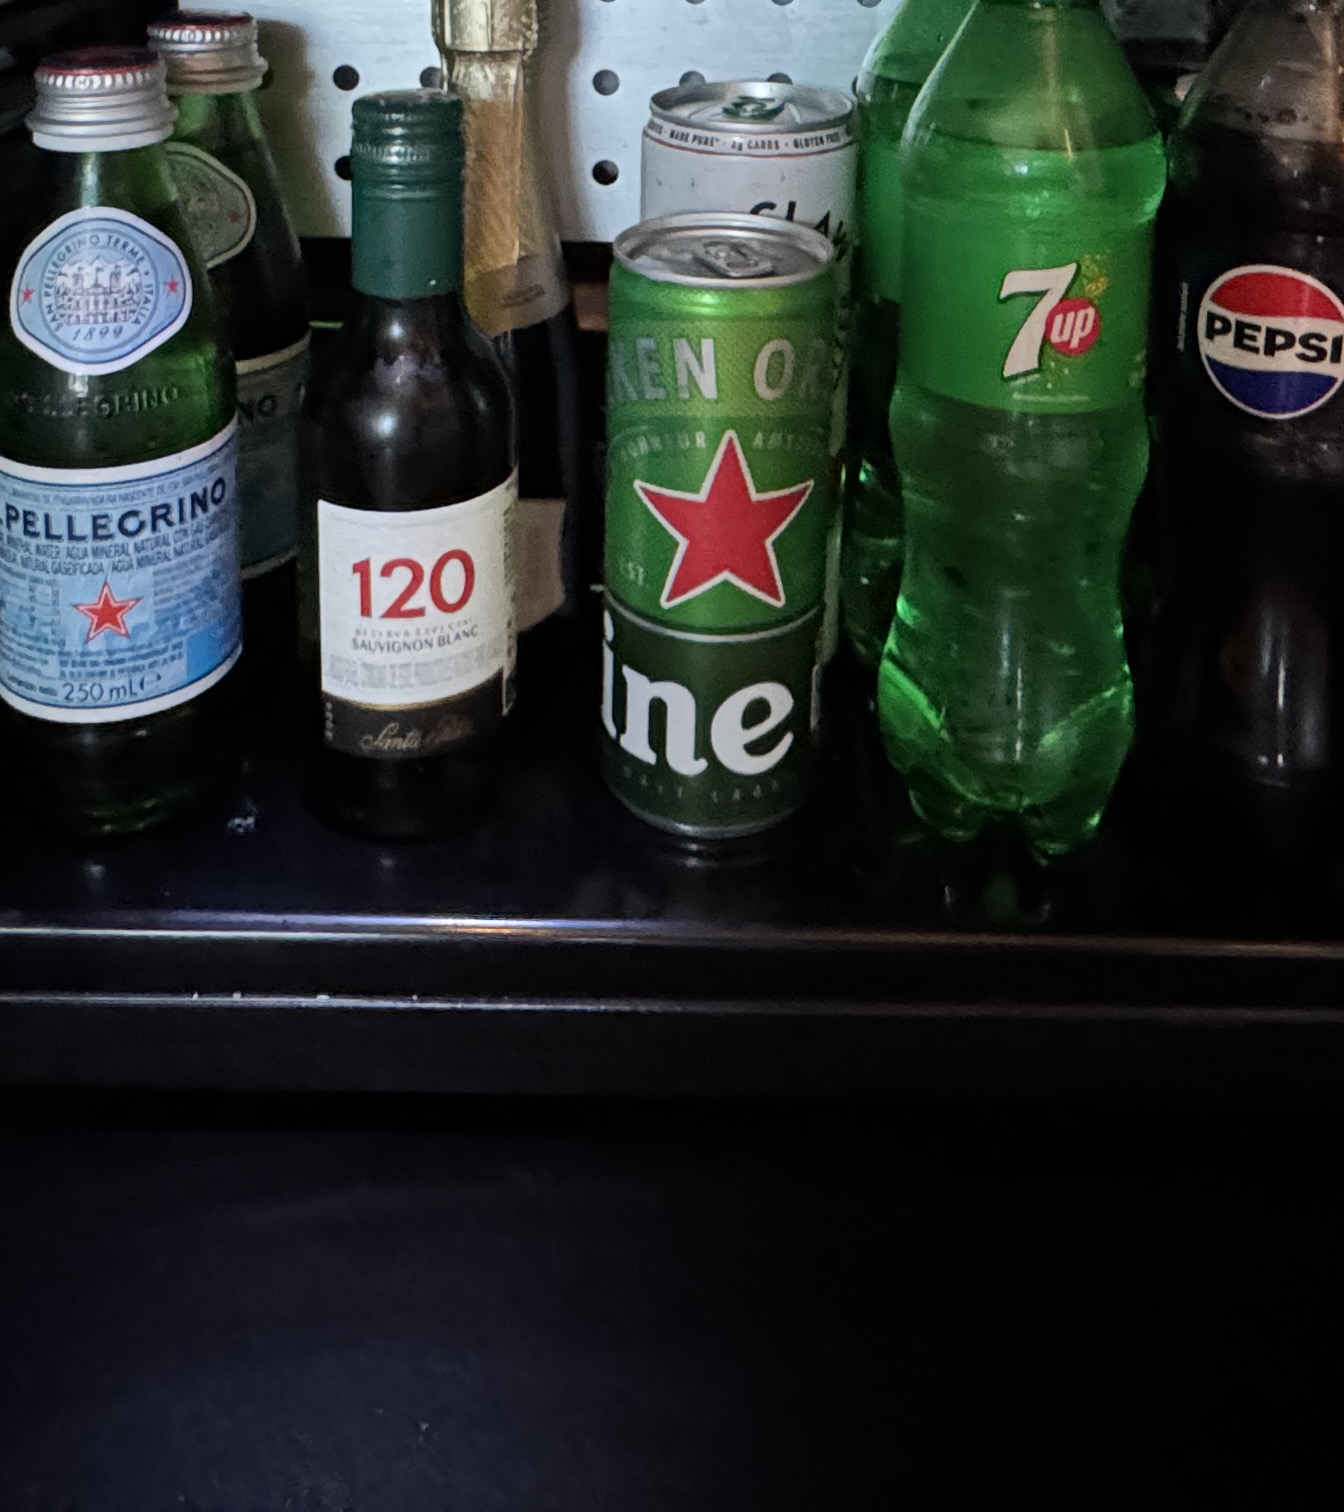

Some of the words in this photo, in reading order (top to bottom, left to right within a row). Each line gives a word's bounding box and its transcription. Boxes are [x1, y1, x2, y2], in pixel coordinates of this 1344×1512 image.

[669, 128, 690, 144] MADE
[747, 138, 780, 151] CARBS
[793, 134, 825, 150] GLUTEN
[107, 234, 147, 265] TERME
[72, 323, 125, 342] 1899
[1206, 311, 1344, 365] PEPSI
[352, 549, 475, 619] 120
[352, 635, 434, 654] SAUVIGNON
[438, 624, 479, 648] BLANC
[63, 682, 104, 702] 250
